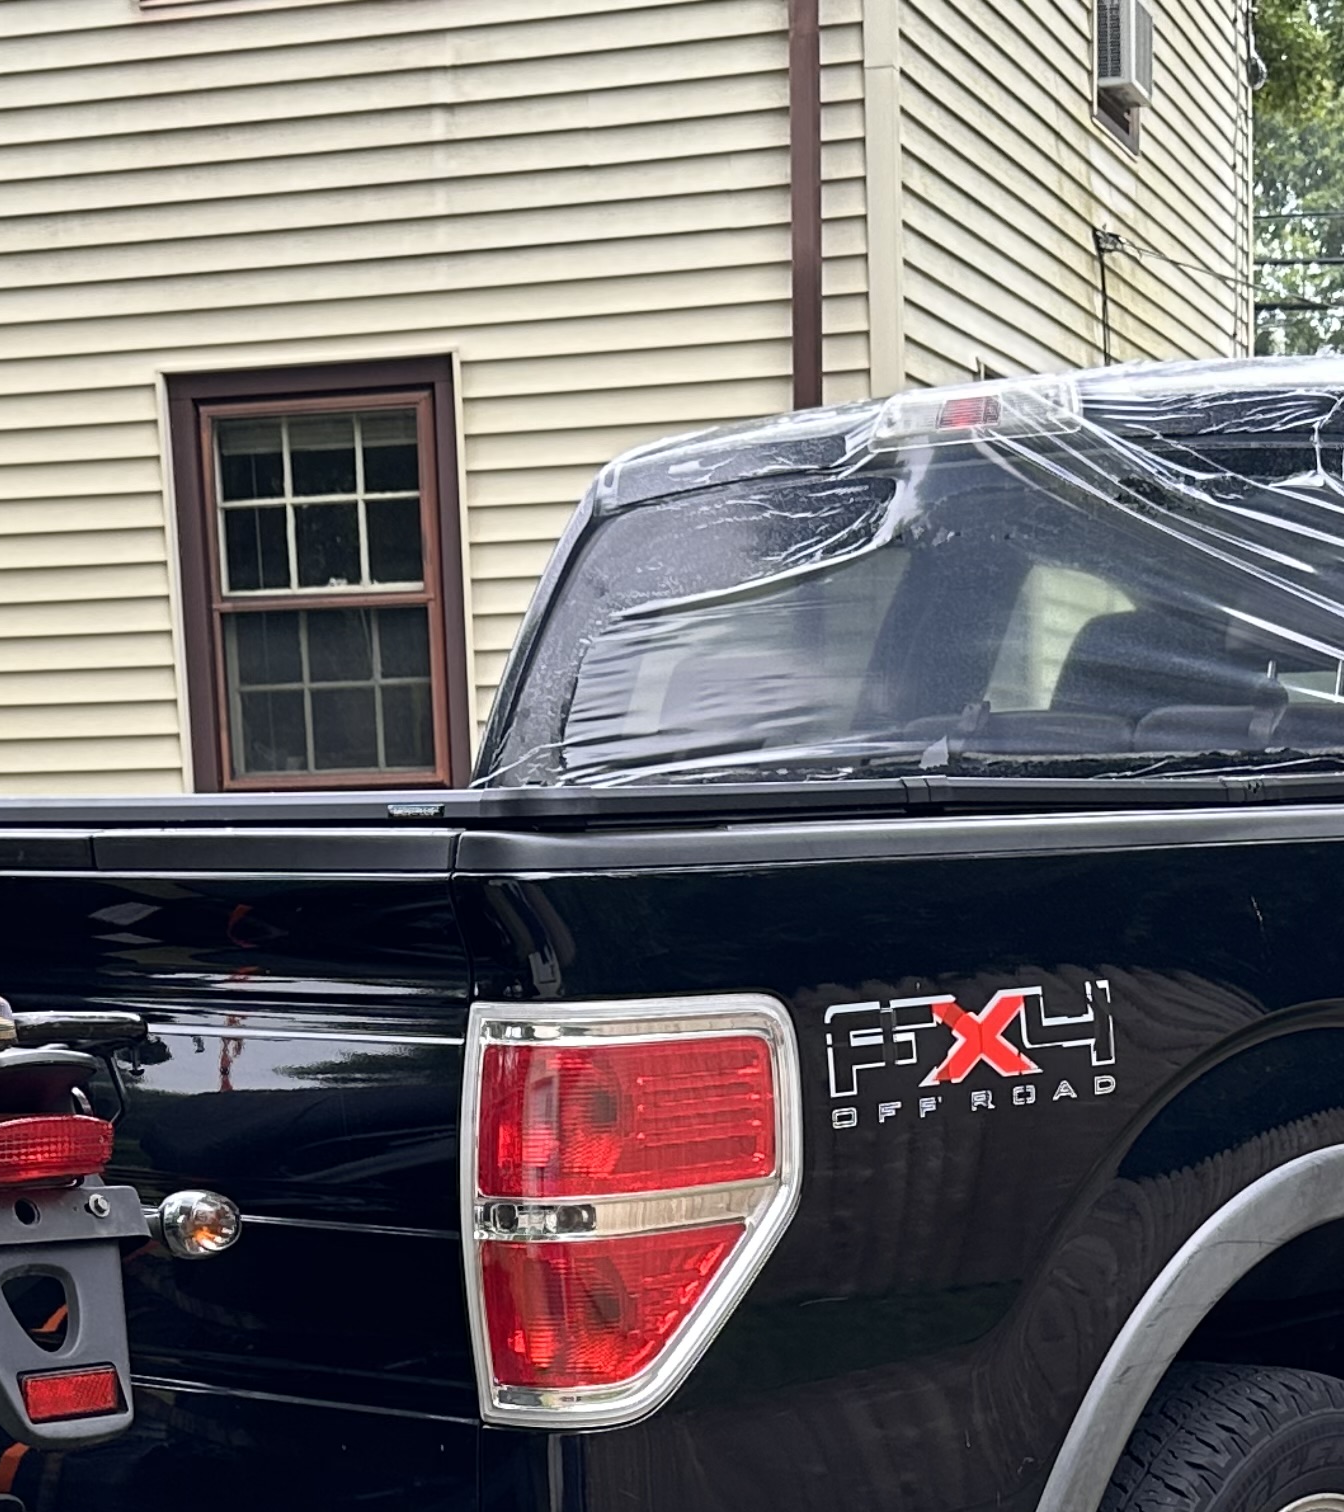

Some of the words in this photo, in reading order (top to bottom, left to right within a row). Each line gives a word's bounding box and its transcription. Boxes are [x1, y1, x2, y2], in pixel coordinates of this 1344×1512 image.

[824, 980, 1116, 1098] FX4
[831, 1097, 942, 1129] OFF
[971, 1075, 1116, 1112] ROAD
